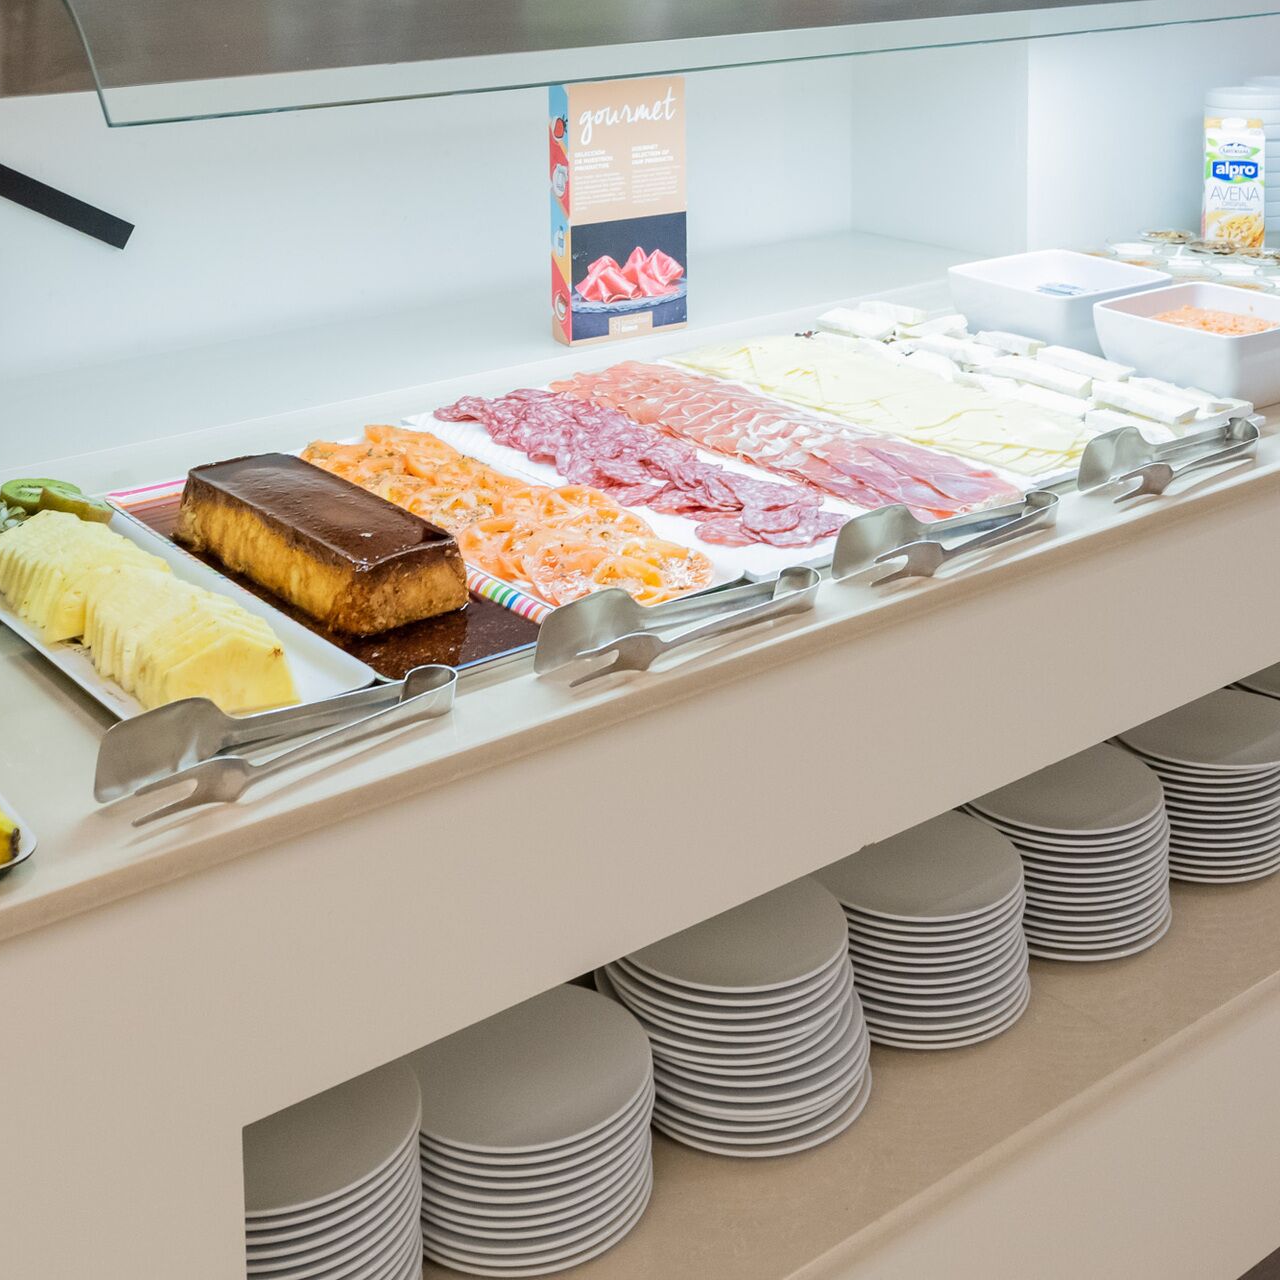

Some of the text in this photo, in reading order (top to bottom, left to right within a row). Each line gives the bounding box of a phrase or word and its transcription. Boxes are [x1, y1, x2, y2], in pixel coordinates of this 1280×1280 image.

[579, 86, 677, 146] gourmet
[1215, 161, 1256, 179] alpro
[1210, 186, 1261, 201] AVENA
